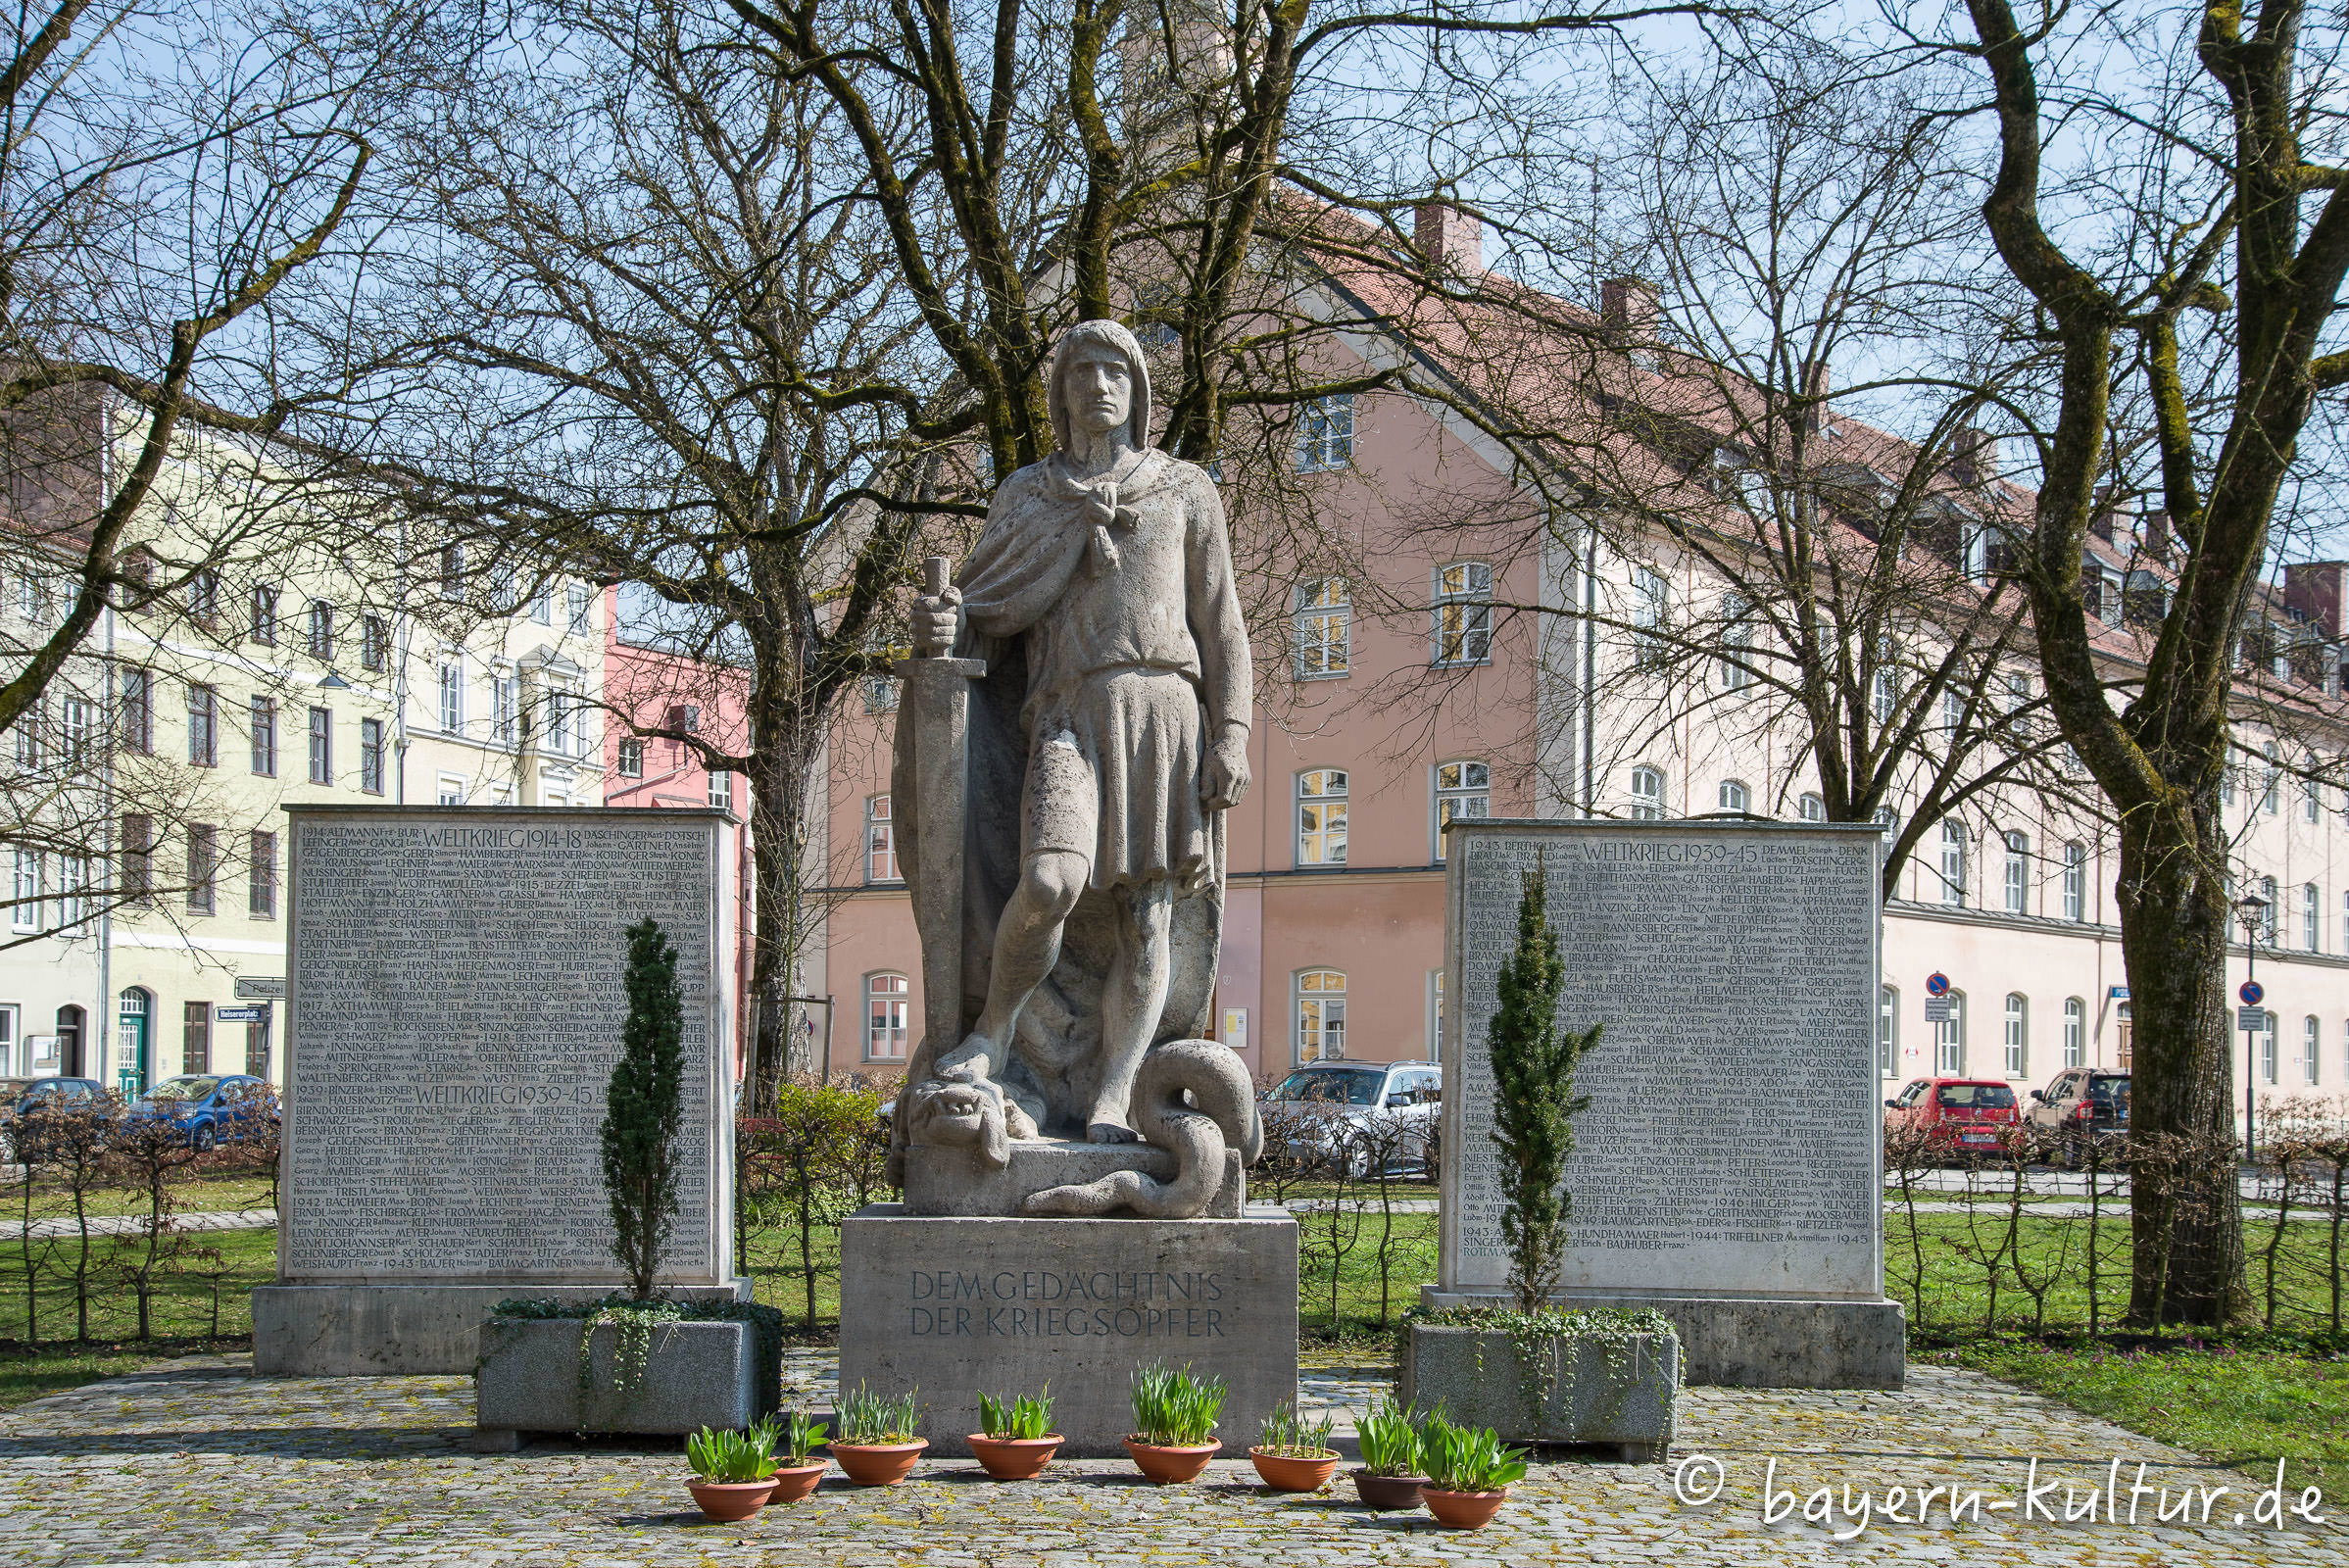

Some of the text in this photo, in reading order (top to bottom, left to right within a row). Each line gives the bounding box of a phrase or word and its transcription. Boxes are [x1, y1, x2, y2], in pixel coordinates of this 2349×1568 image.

[423, 828, 581, 850] WELTKRIEG 1914-18
[1583, 842, 1757, 863] WELTKRIEG 1939-45
[253, 984, 283, 994] Polizei
[416, 1085, 593, 1105] WELTKRIEG 1939-45
[911, 1270, 1223, 1301] DEM GEDÄCHTNIS
[911, 1307, 1225, 1337] DER KRIEGSOPFER
